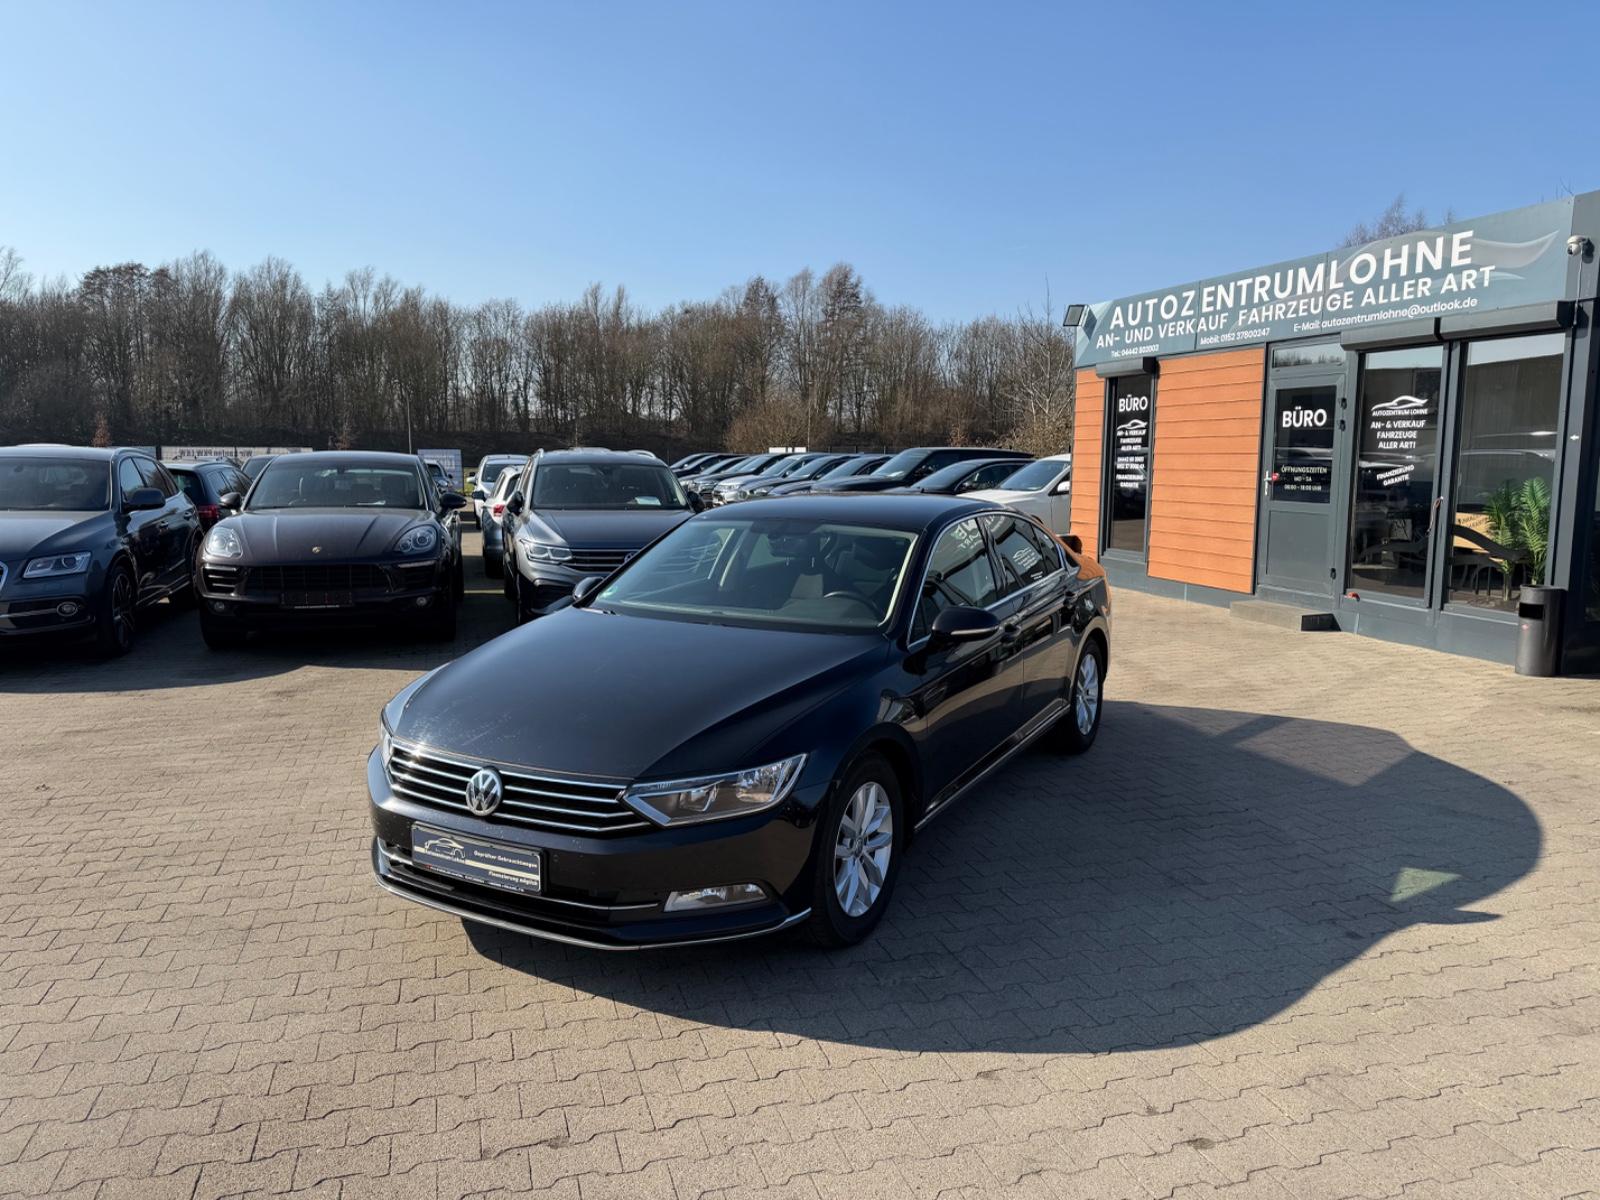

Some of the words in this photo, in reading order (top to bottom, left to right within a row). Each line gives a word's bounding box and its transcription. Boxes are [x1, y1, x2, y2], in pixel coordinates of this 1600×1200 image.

[1096, 333, 1120, 349] AN-
[1125, 326, 1154, 345] UND
[1158, 313, 1229, 339] VERKAUF
[1238, 291, 1354, 327] FAHRZEUGE
[1361, 277, 1432, 307] ALLER
[1440, 265, 1496, 295] ART
[1321, 297, 1478, 328] autozentrumlohne@outlook.de
[1220, 332, 1236, 343] 0152
[1118, 394, 1148, 413] BÜRO
[1282, 406, 1327, 428] BÜRO
[1370, 421, 1385, 429] AN-
[1386, 420, 1392, 428] &
[1393, 419, 1426, 428] VERKAUF
[1377, 430, 1418, 439] FAHRZEUGE
[1378, 441, 1398, 449] ALLER
[1281, 465, 1328, 474] ÖFFNUNGSZEITEN
